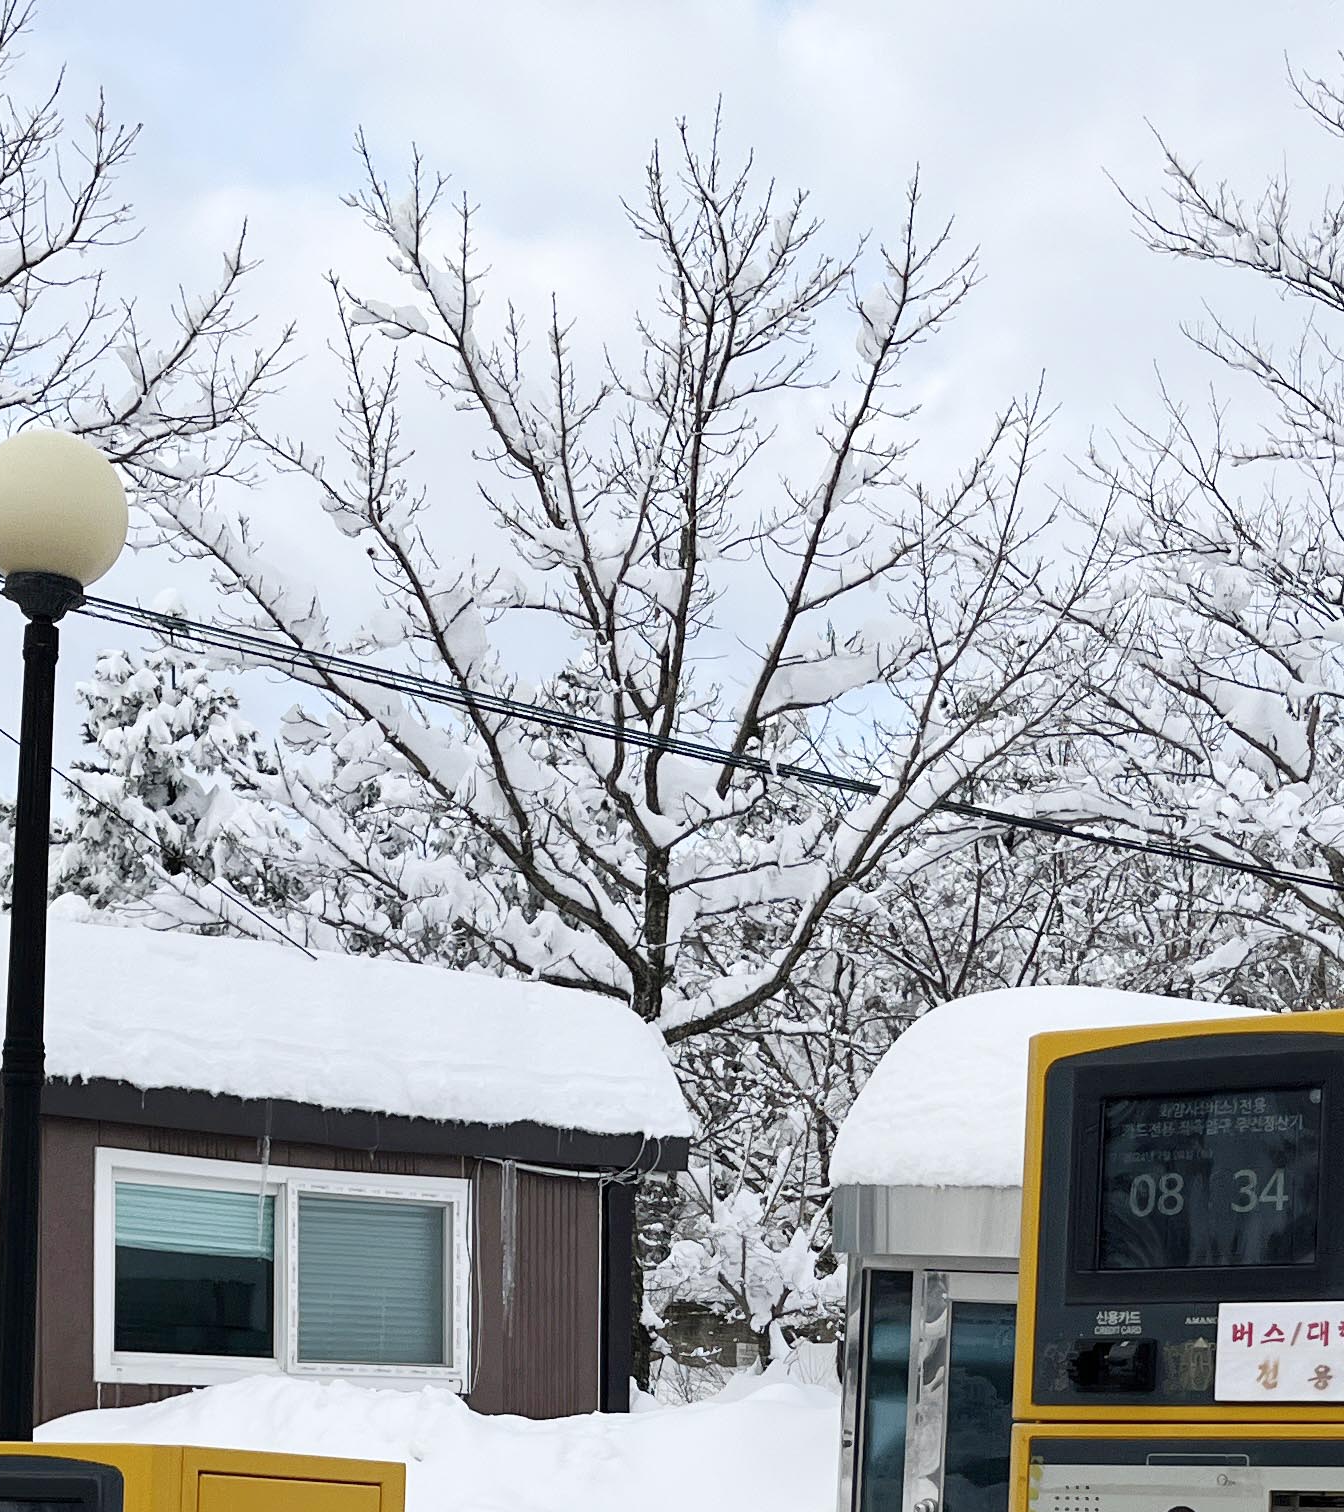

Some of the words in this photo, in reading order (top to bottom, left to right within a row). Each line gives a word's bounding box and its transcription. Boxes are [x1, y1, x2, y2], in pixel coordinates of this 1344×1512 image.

[1129, 1173, 1185, 1217] 08
[1231, 1168, 1289, 1214] 34
[1096, 1311, 1141, 1325] 신용카드
[1121, 1325, 1142, 1335] CARD
